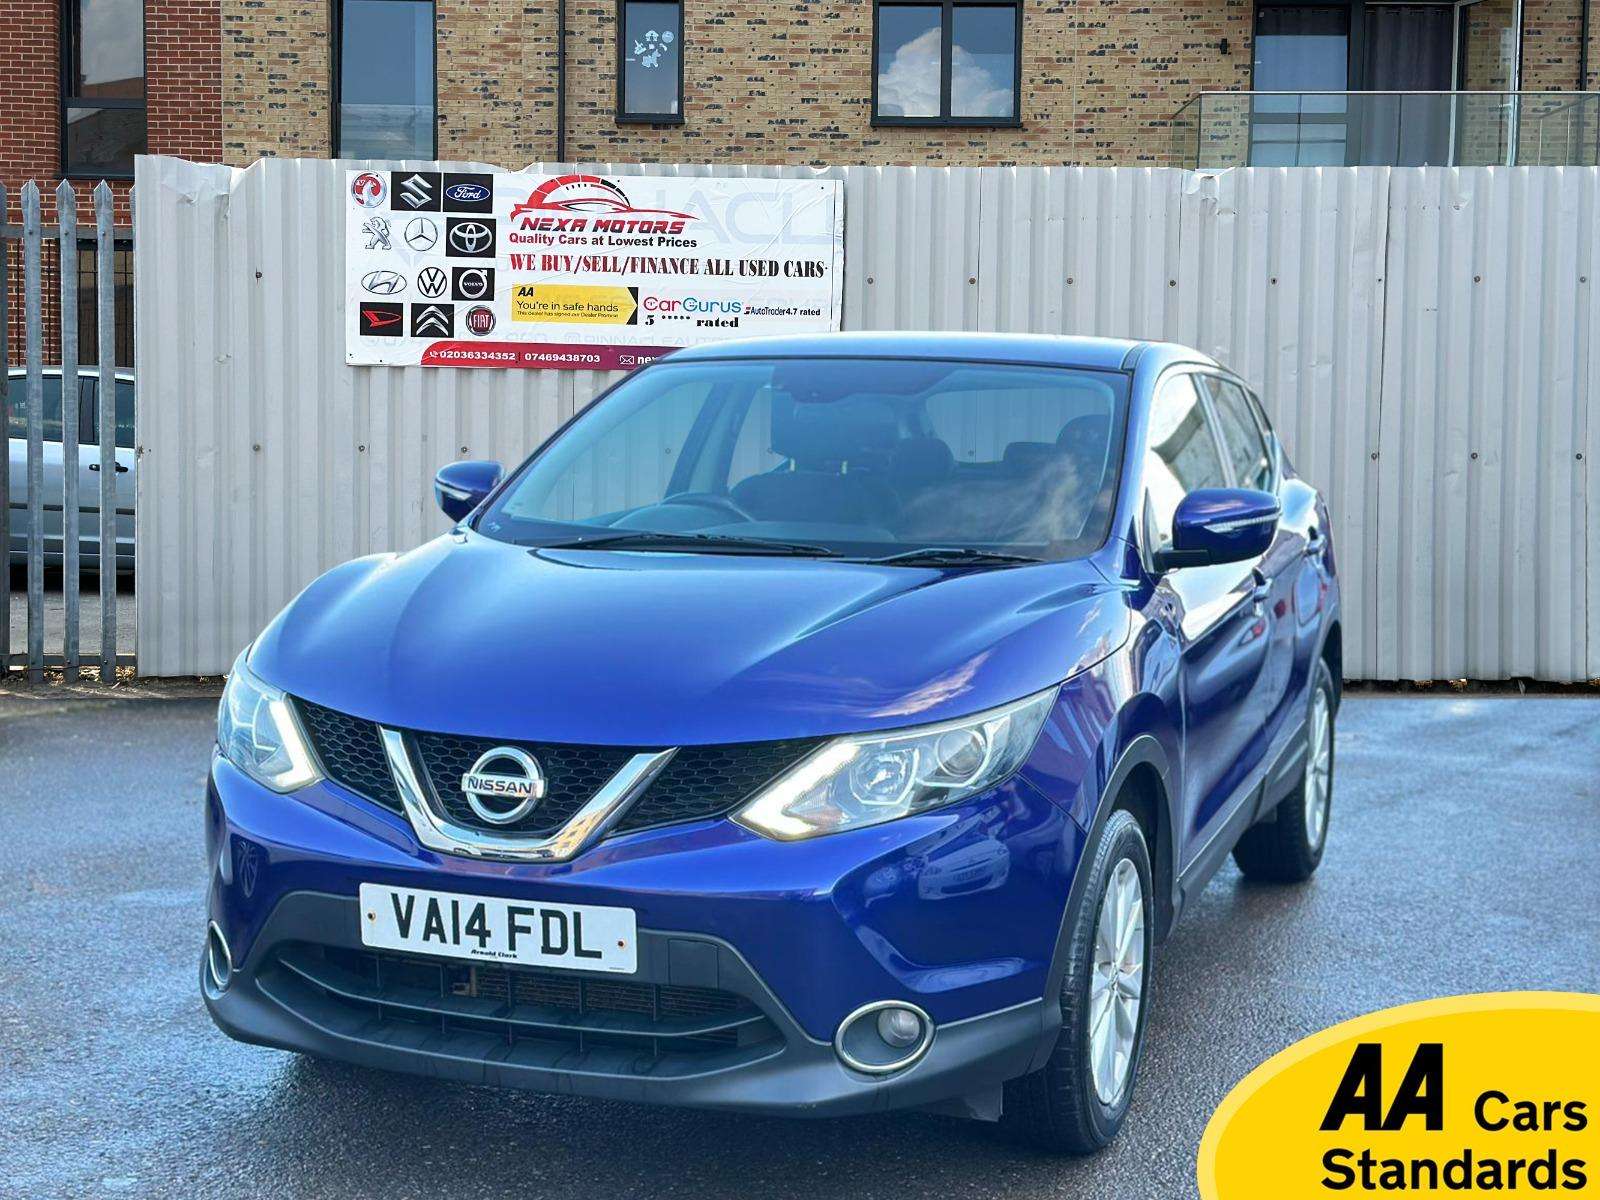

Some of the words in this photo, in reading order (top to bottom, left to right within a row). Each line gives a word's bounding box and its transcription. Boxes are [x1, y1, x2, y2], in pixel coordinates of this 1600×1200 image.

[454, 186, 481, 199] Ford
[520, 217, 587, 232] NEXA
[592, 219, 685, 234] MOTORS
[509, 232, 554, 246] Quality
[558, 234, 588, 245] Cars
[591, 236, 604, 246] at
[608, 235, 654, 246] Lowest
[657, 236, 697, 248] Prices
[509, 253, 536, 271] WE
[703, 258, 734, 276] ALL
[739, 259, 779, 277] USED
[517, 287, 534, 297] AA
[516, 300, 549, 310] You're
[551, 301, 560, 310] in
[563, 302, 585, 311] safe
[587, 303, 619, 312] hands
[643, 296, 742, 313] CarGurus
[800, 308, 821, 316] rated
[472, 314, 489, 328] FIAT
[645, 314, 655, 326] 5
[696, 316, 739, 328] rated
[439, 350, 516, 360] 02036334352
[525, 352, 600, 363] 07469438703
[468, 776, 532, 795] NISSAN
[390, 892, 492, 949] VA14
[507, 905, 603, 960] FDL
